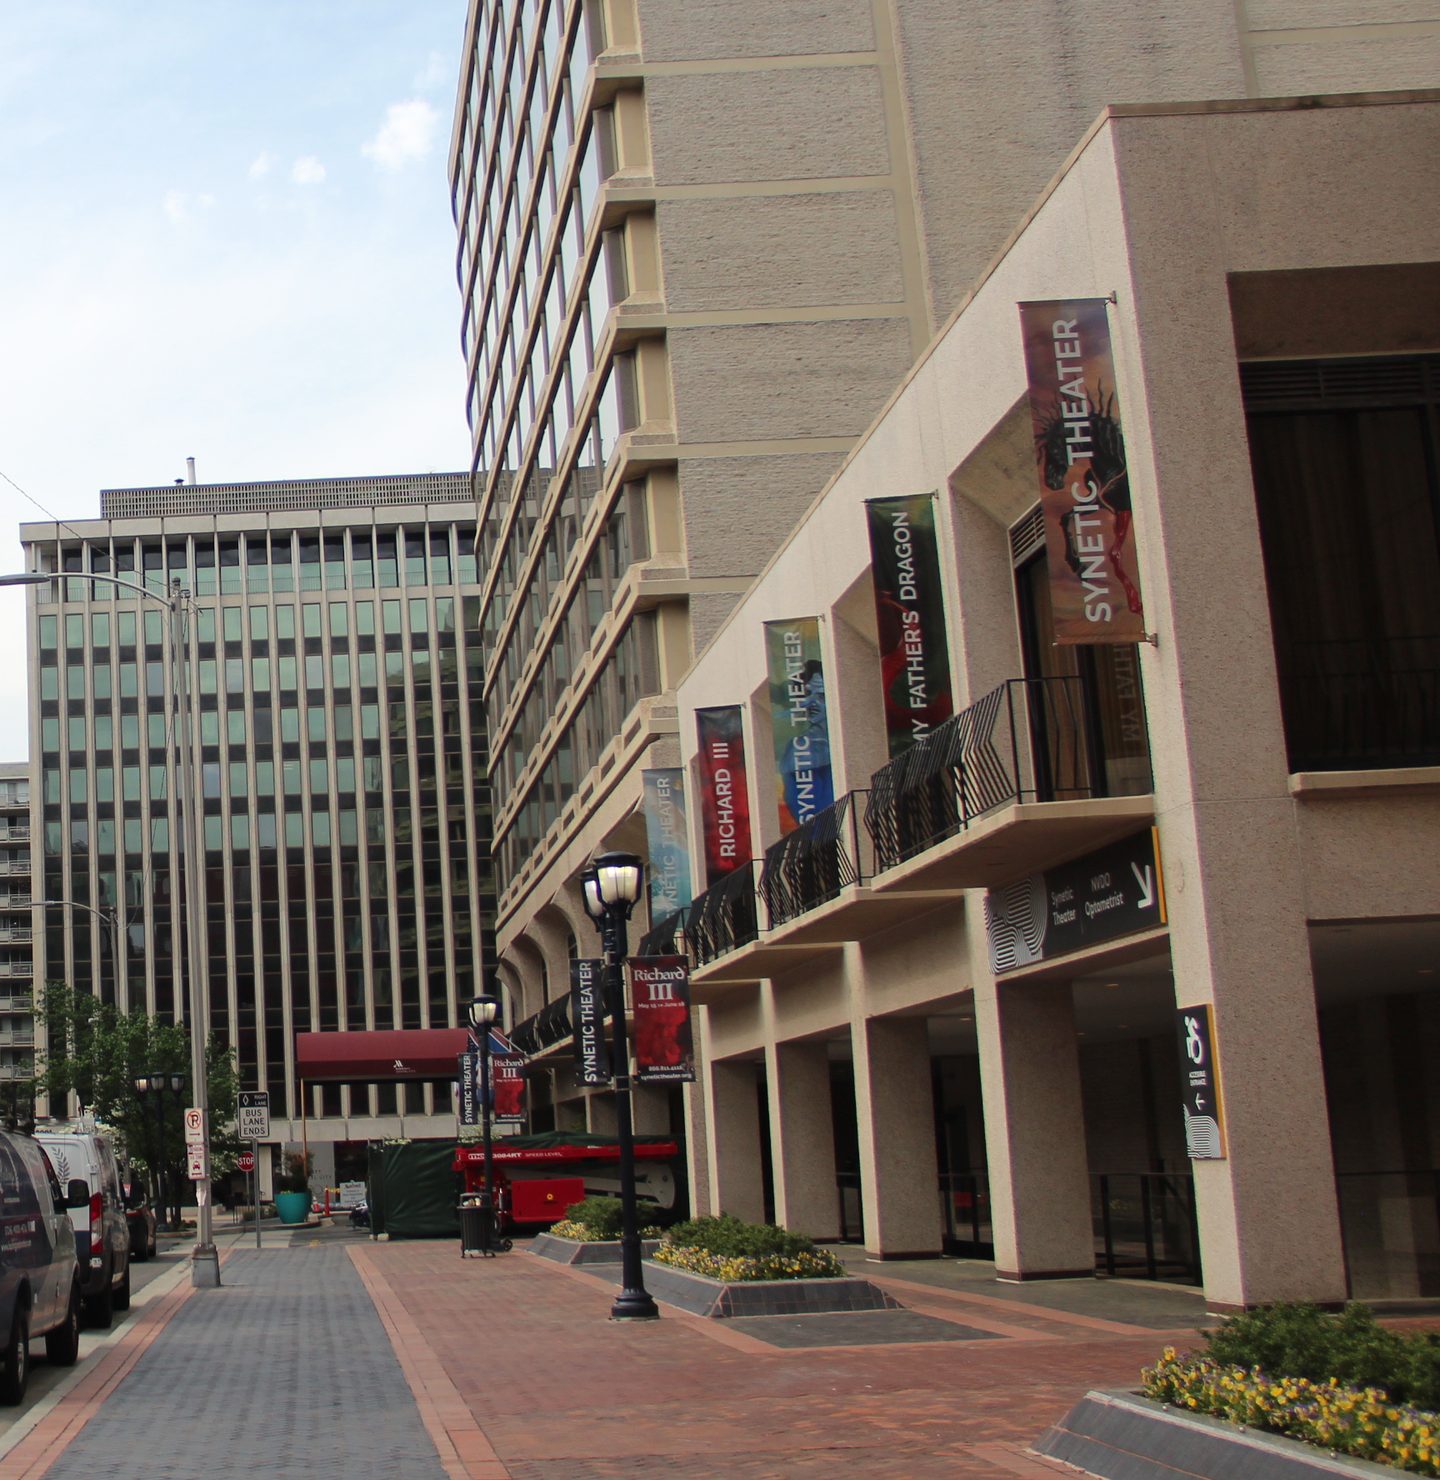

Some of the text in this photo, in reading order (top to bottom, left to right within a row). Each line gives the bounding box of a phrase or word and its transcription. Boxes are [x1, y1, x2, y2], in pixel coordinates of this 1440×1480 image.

[1052, 318, 1112, 623] SYNETIC THEATER
[891, 511, 917, 600] DRAGON
[902, 610, 928, 708] FATHER'S
[784, 631, 808, 727] THEATER
[656, 777, 673, 849] THEATER
[712, 742, 736, 857] RICHARD III
[1052, 909, 1077, 926] Theater
[1084, 890, 1125, 919] Optometrist
[634, 966, 685, 981] Richard
[646, 983, 673, 1000] III
[579, 962, 597, 1082] SYNETIC THEATER
[494, 1058, 524, 1067] Richard
[502, 1068, 517, 1078] III
[463, 1055, 473, 1123] SYNETIC THEATER
[243, 1118, 265, 1126] LANE
[245, 1109, 262, 1117] BUS
[243, 1127, 266, 1135] ENDS
